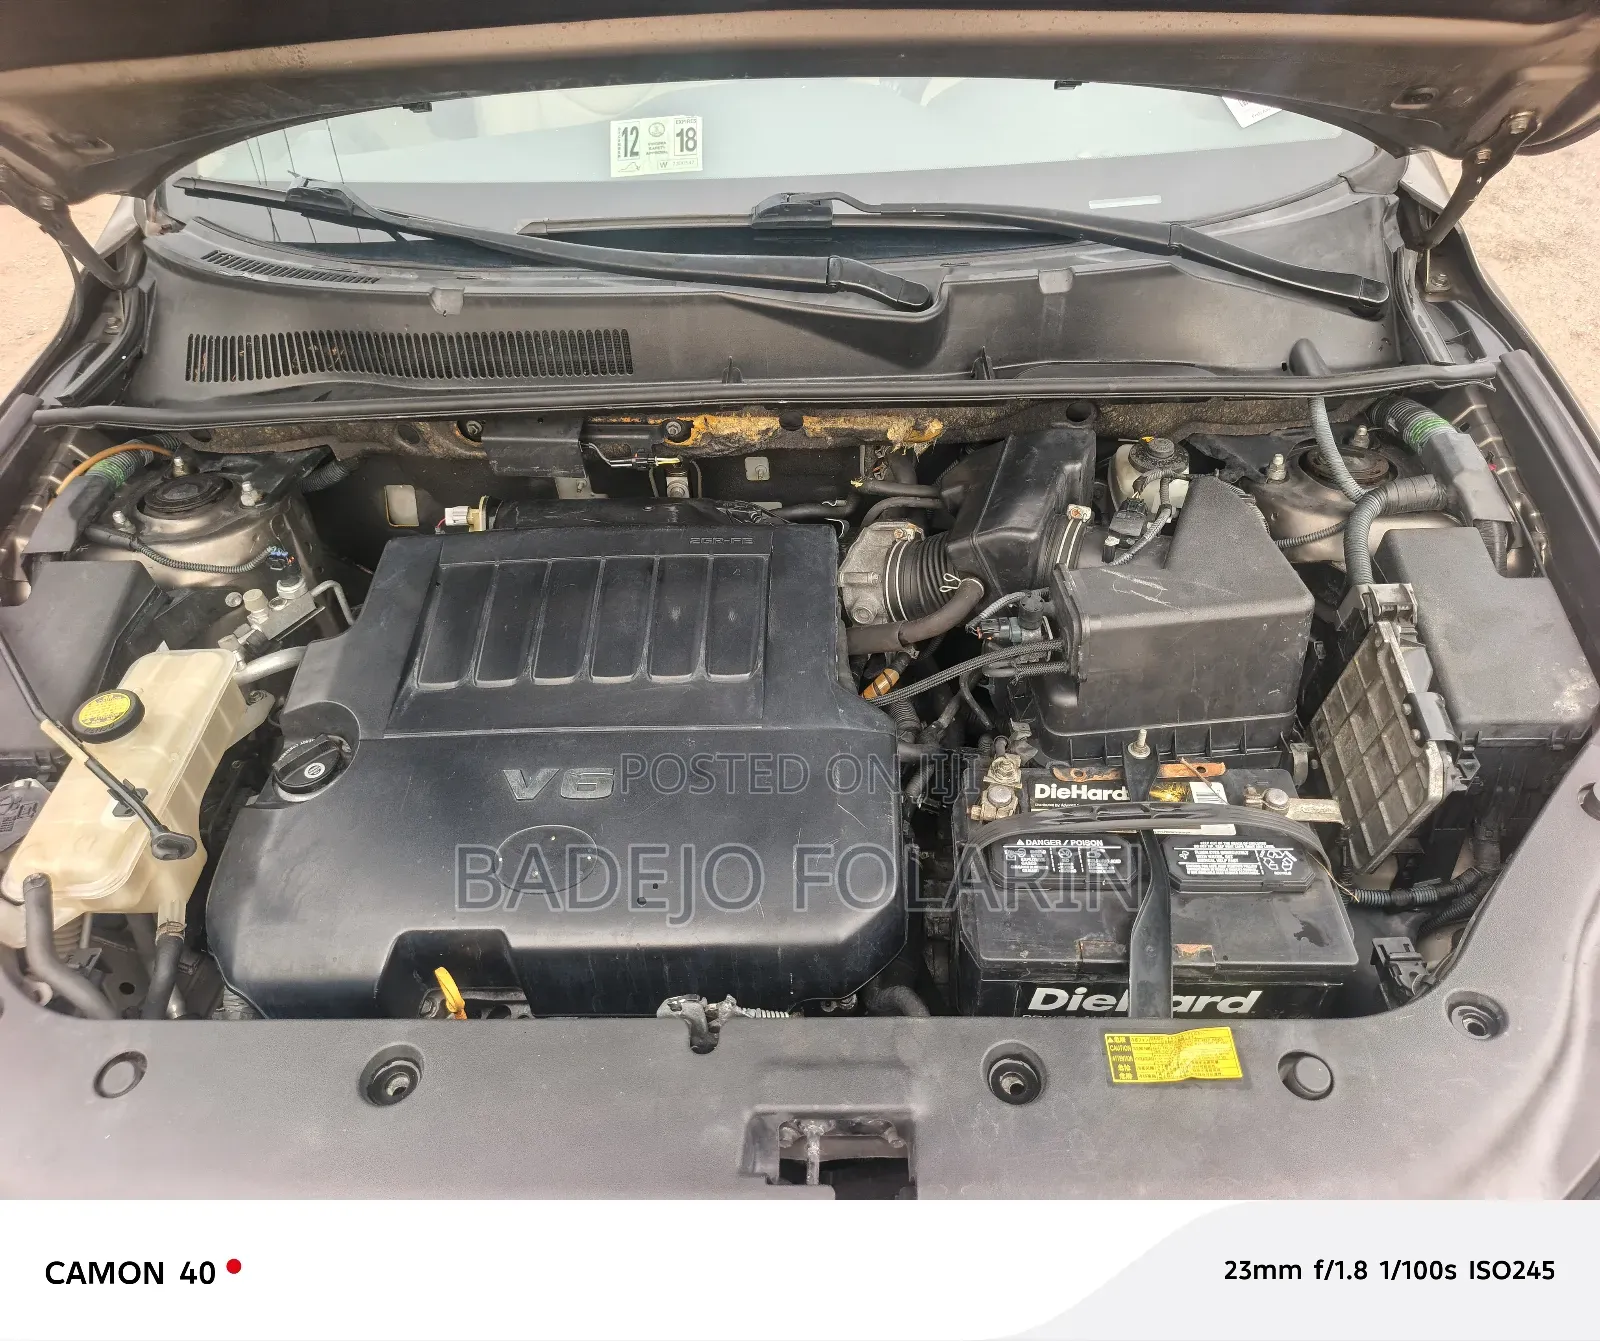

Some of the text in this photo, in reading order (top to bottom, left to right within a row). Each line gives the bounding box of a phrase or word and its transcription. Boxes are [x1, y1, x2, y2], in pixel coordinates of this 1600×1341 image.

[621, 126, 640, 158] 12
[676, 127, 697, 152] 18
[659, 161, 668, 169] W
[501, 767, 616, 800] V6
[1034, 783, 1131, 801] DieHard
[1028, 986, 1263, 1013] Dieard
